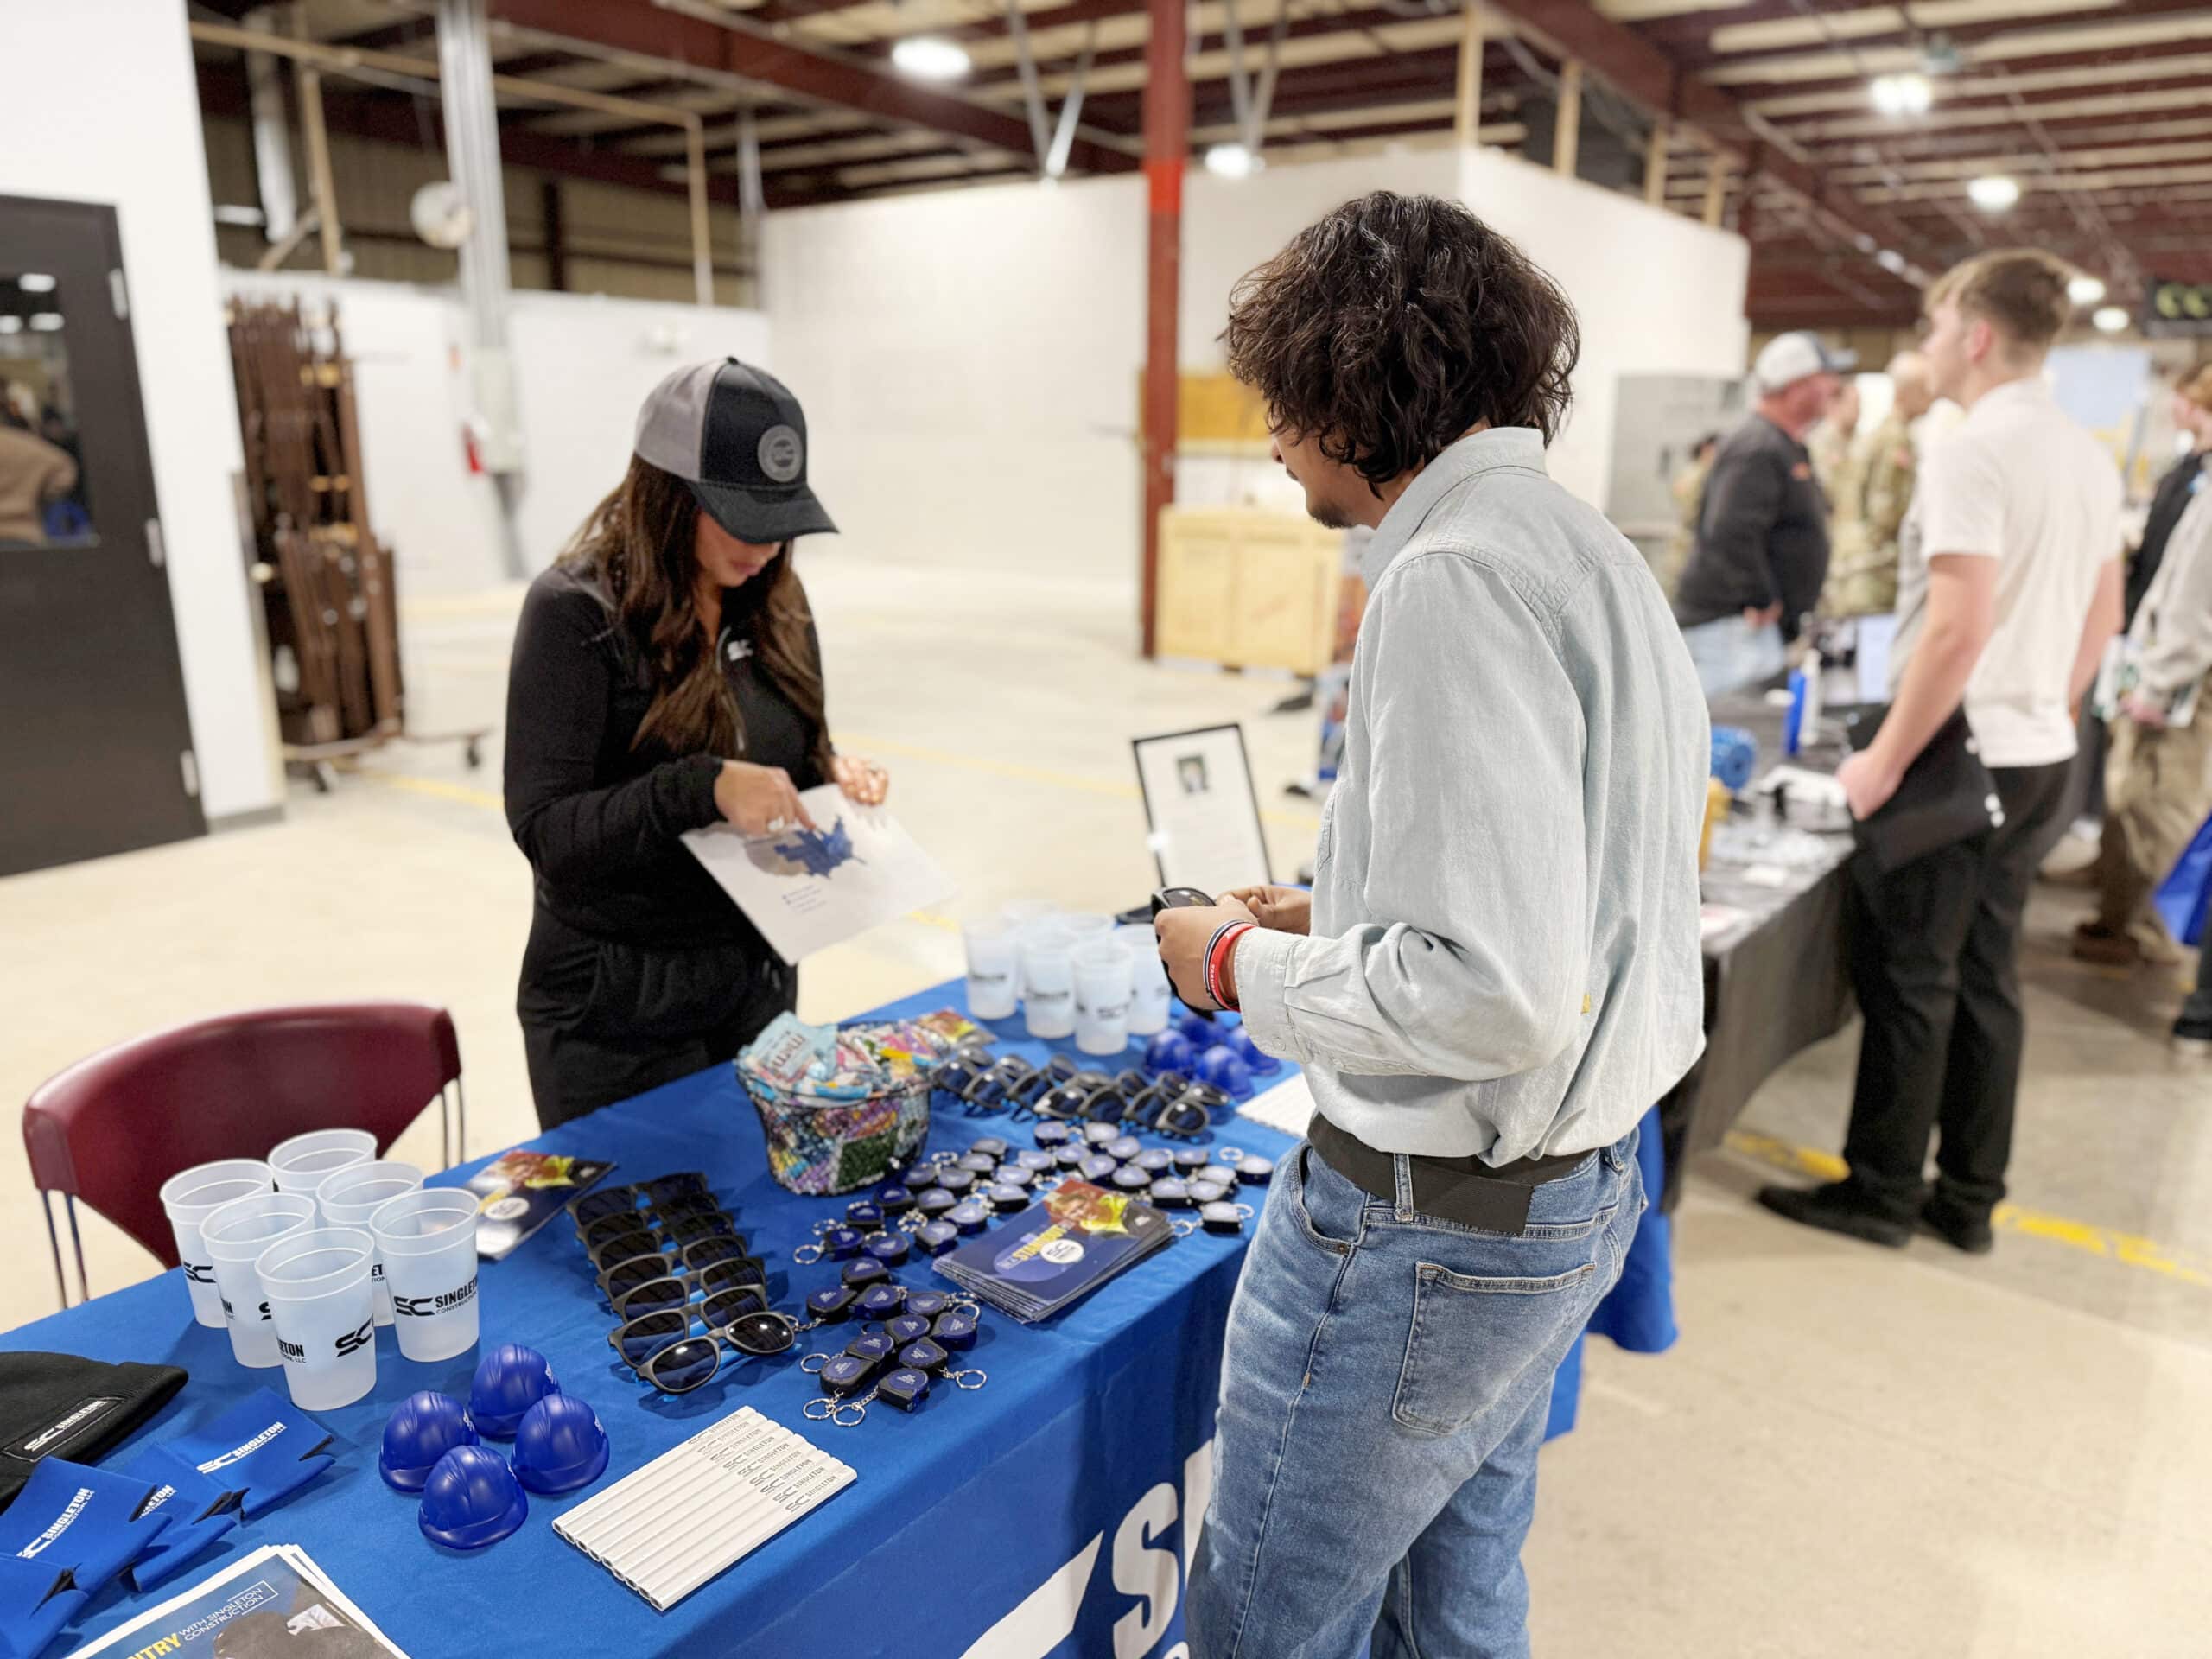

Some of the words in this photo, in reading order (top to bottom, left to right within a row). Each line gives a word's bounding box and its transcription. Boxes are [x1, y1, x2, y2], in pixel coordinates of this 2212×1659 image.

[394, 1295, 435, 1317] SC
[276, 1338, 305, 1357] ETON
[24, 1427, 64, 1452] SC
[196, 1452, 238, 1474] SC
[232, 1421, 284, 1456] SINGLETON
[41, 1487, 91, 1540] SINGLETON
[179, 1619, 207, 1637] WITH
[207, 1587, 264, 1620] SINGLETON
[184, 1594, 264, 1641] CONSTRUCTION
